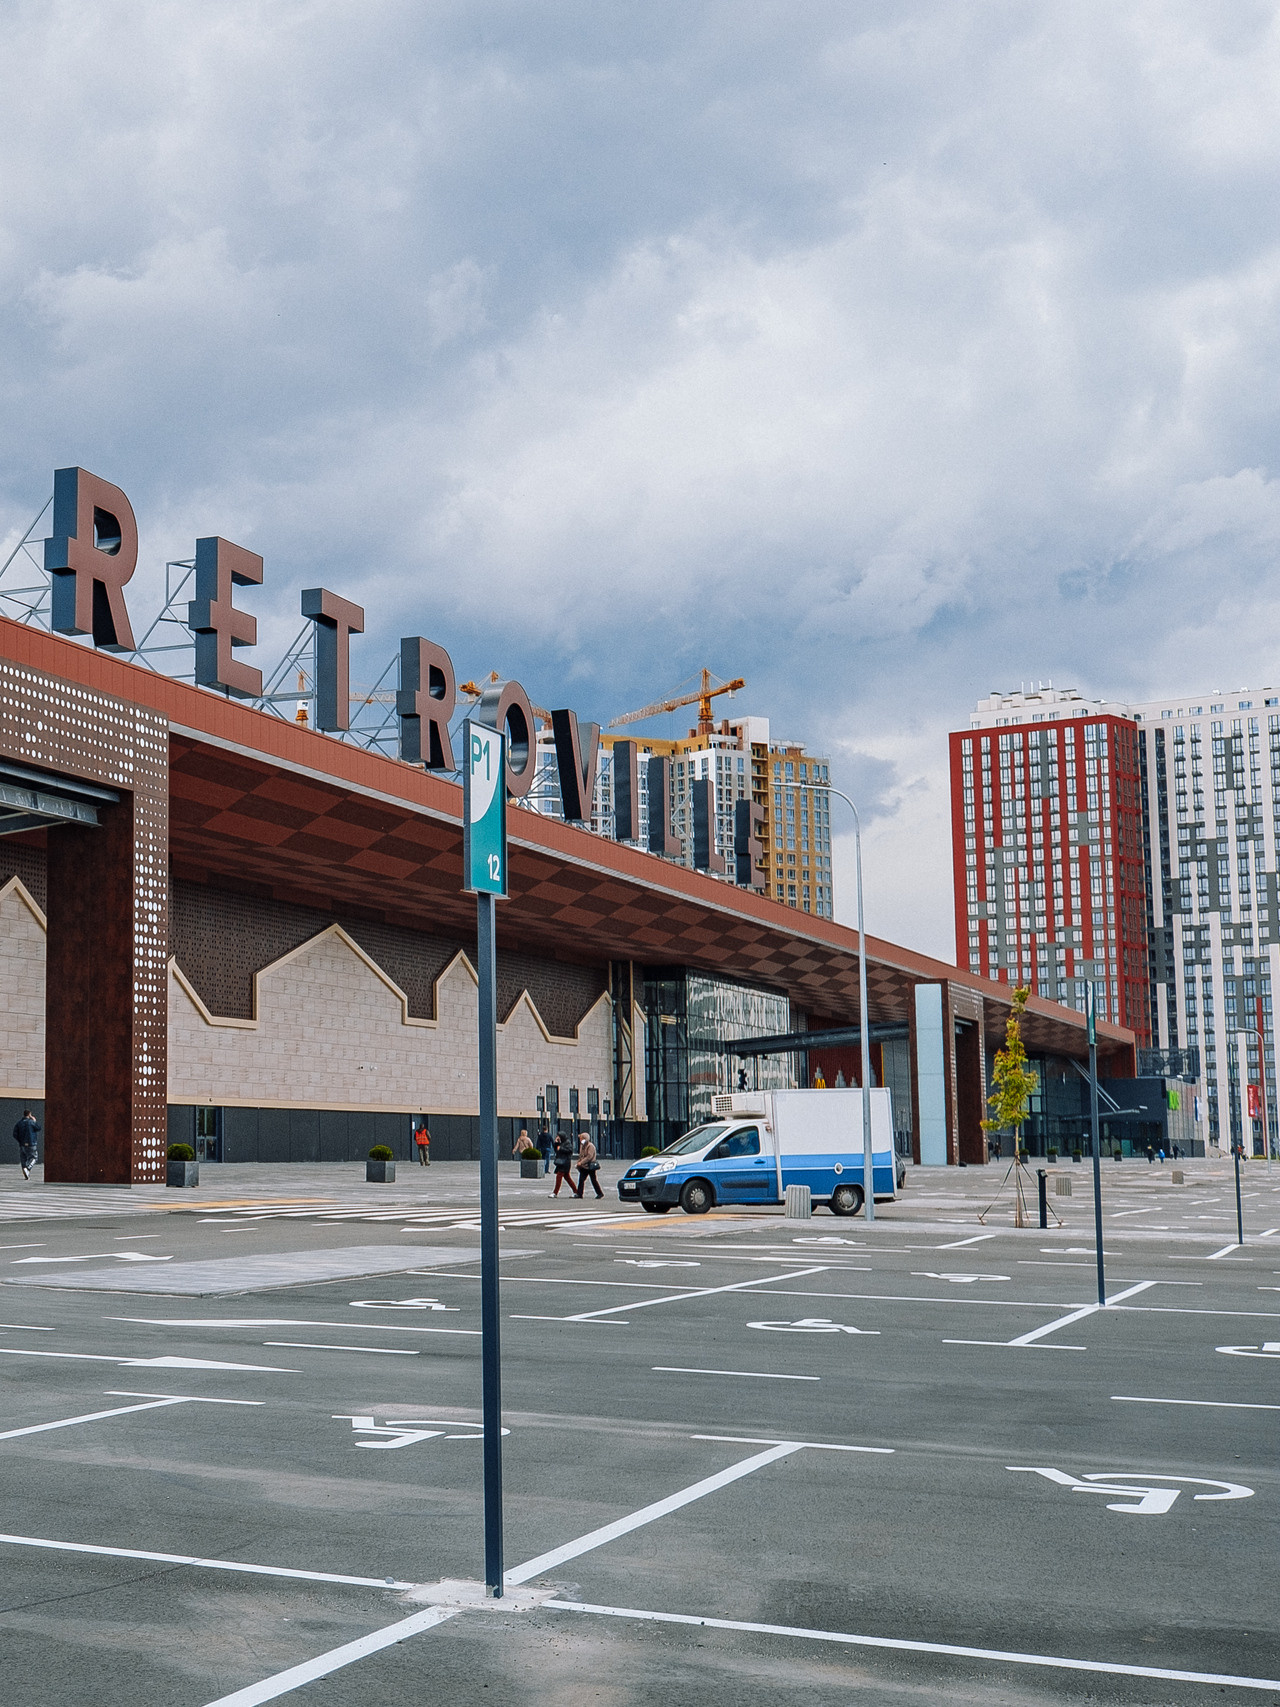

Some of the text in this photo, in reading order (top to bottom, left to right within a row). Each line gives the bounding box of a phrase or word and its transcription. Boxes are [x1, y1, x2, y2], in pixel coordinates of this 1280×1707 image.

[44, 466, 765, 889] RETROVILLE
[471, 733, 491, 781] P1
[487, 853, 501, 882] 12
